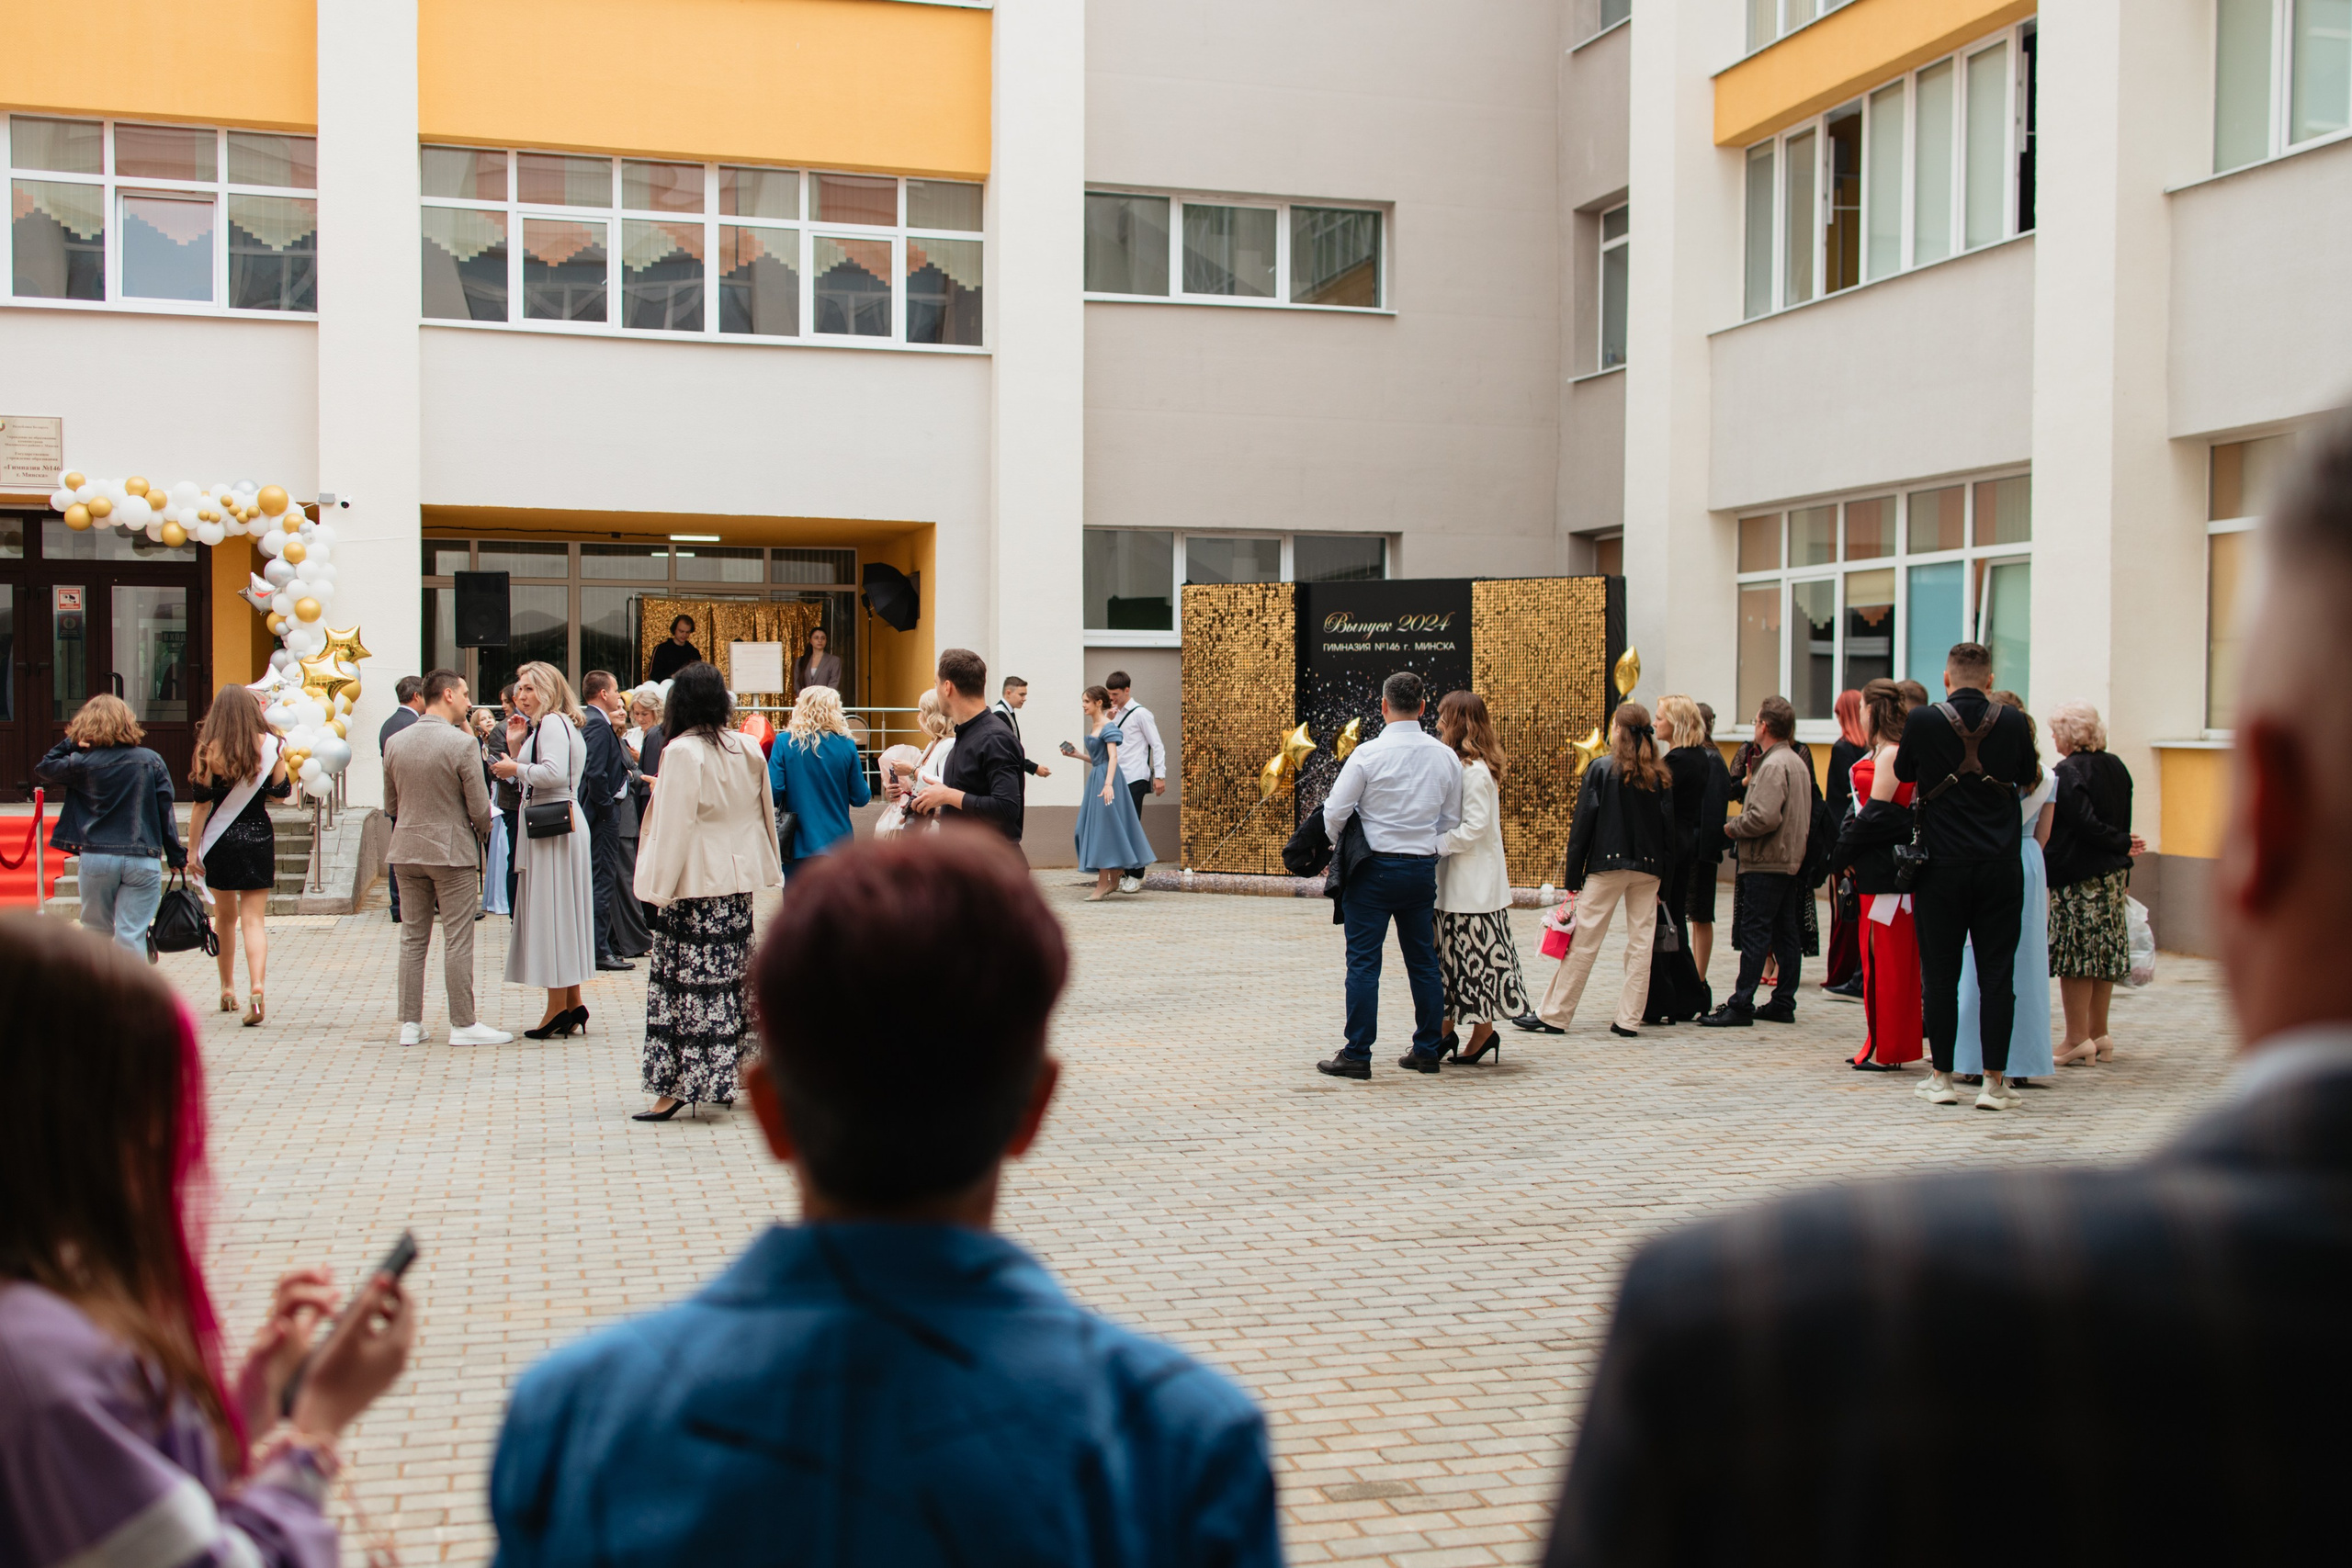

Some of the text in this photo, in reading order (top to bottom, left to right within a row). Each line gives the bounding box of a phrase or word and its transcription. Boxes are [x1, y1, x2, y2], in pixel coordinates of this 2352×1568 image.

[1323, 611, 1455, 641] Выпуск 2024
[1323, 642, 1372, 652] ГИМНАЗИЯ
[1374, 642, 1401, 652] №146
[1415, 641, 1456, 651] МИНСКА
